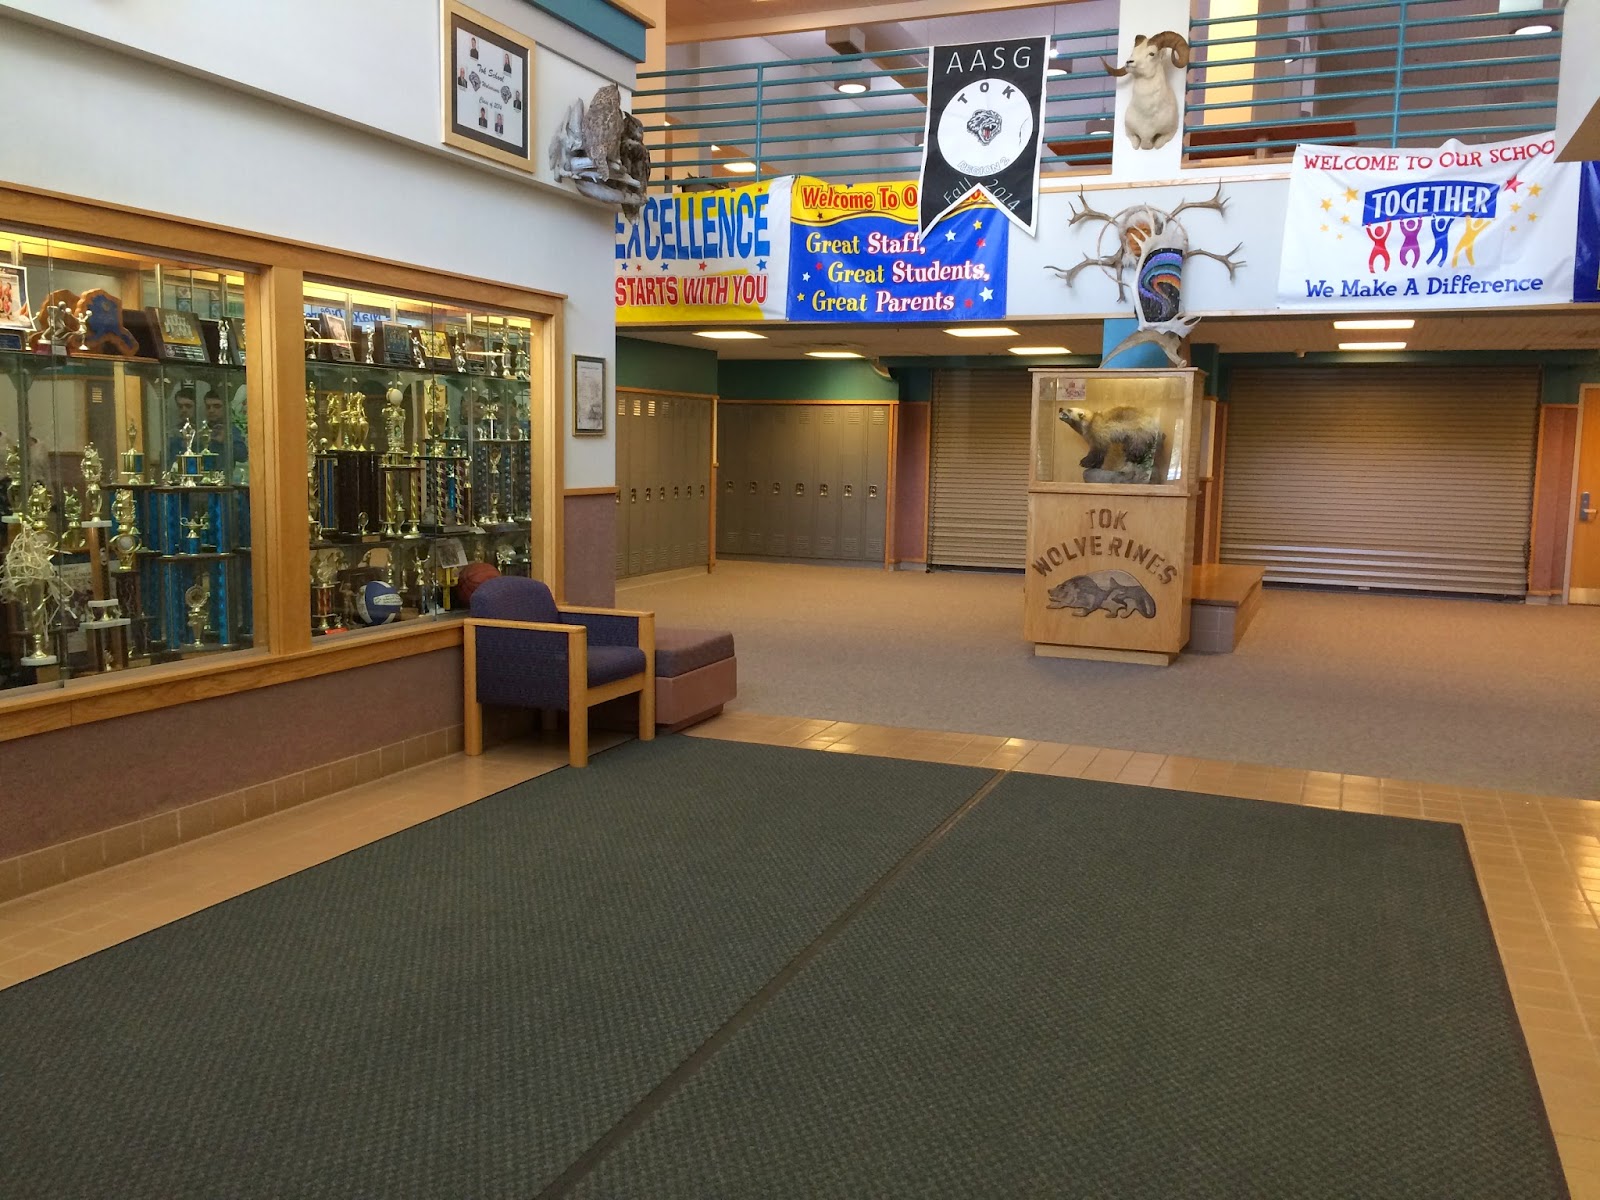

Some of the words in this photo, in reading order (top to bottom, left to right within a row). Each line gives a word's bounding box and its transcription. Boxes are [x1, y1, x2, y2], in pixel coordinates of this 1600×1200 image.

[946, 46, 1031, 75] AASG
[957, 82, 1015, 104] TOK
[957, 160, 1001, 175] REGION
[1304, 154, 1399, 171] WELCOME
[1407, 155, 1433, 170] TO
[1439, 150, 1482, 169] OUR
[1490, 139, 1556, 164] SCHOO
[801, 186, 874, 211] Welcome
[879, 187, 900, 209] To
[943, 177, 972, 206] Fall
[984, 178, 1021, 212] 2014
[1371, 185, 1489, 219] TOGETHER
[615, 193, 770, 260] EXCELLENCE
[806, 233, 861, 255] Great
[867, 231, 927, 255] Staff,
[827, 261, 885, 284] Great
[891, 259, 991, 283] Students,
[615, 275, 679, 306] STARTS
[682, 275, 730, 305] WITH
[732, 273, 769, 304] YOU
[1305, 279, 1335, 298] We
[1340, 278, 1397, 297] Make
[1403, 277, 1420, 296] A
[1427, 275, 1544, 296] Difference
[811, 290, 868, 313] Great
[875, 288, 956, 312] Parents
[1086, 509, 1128, 530] TOK
[1032, 536, 1177, 584] WOLVERINES
